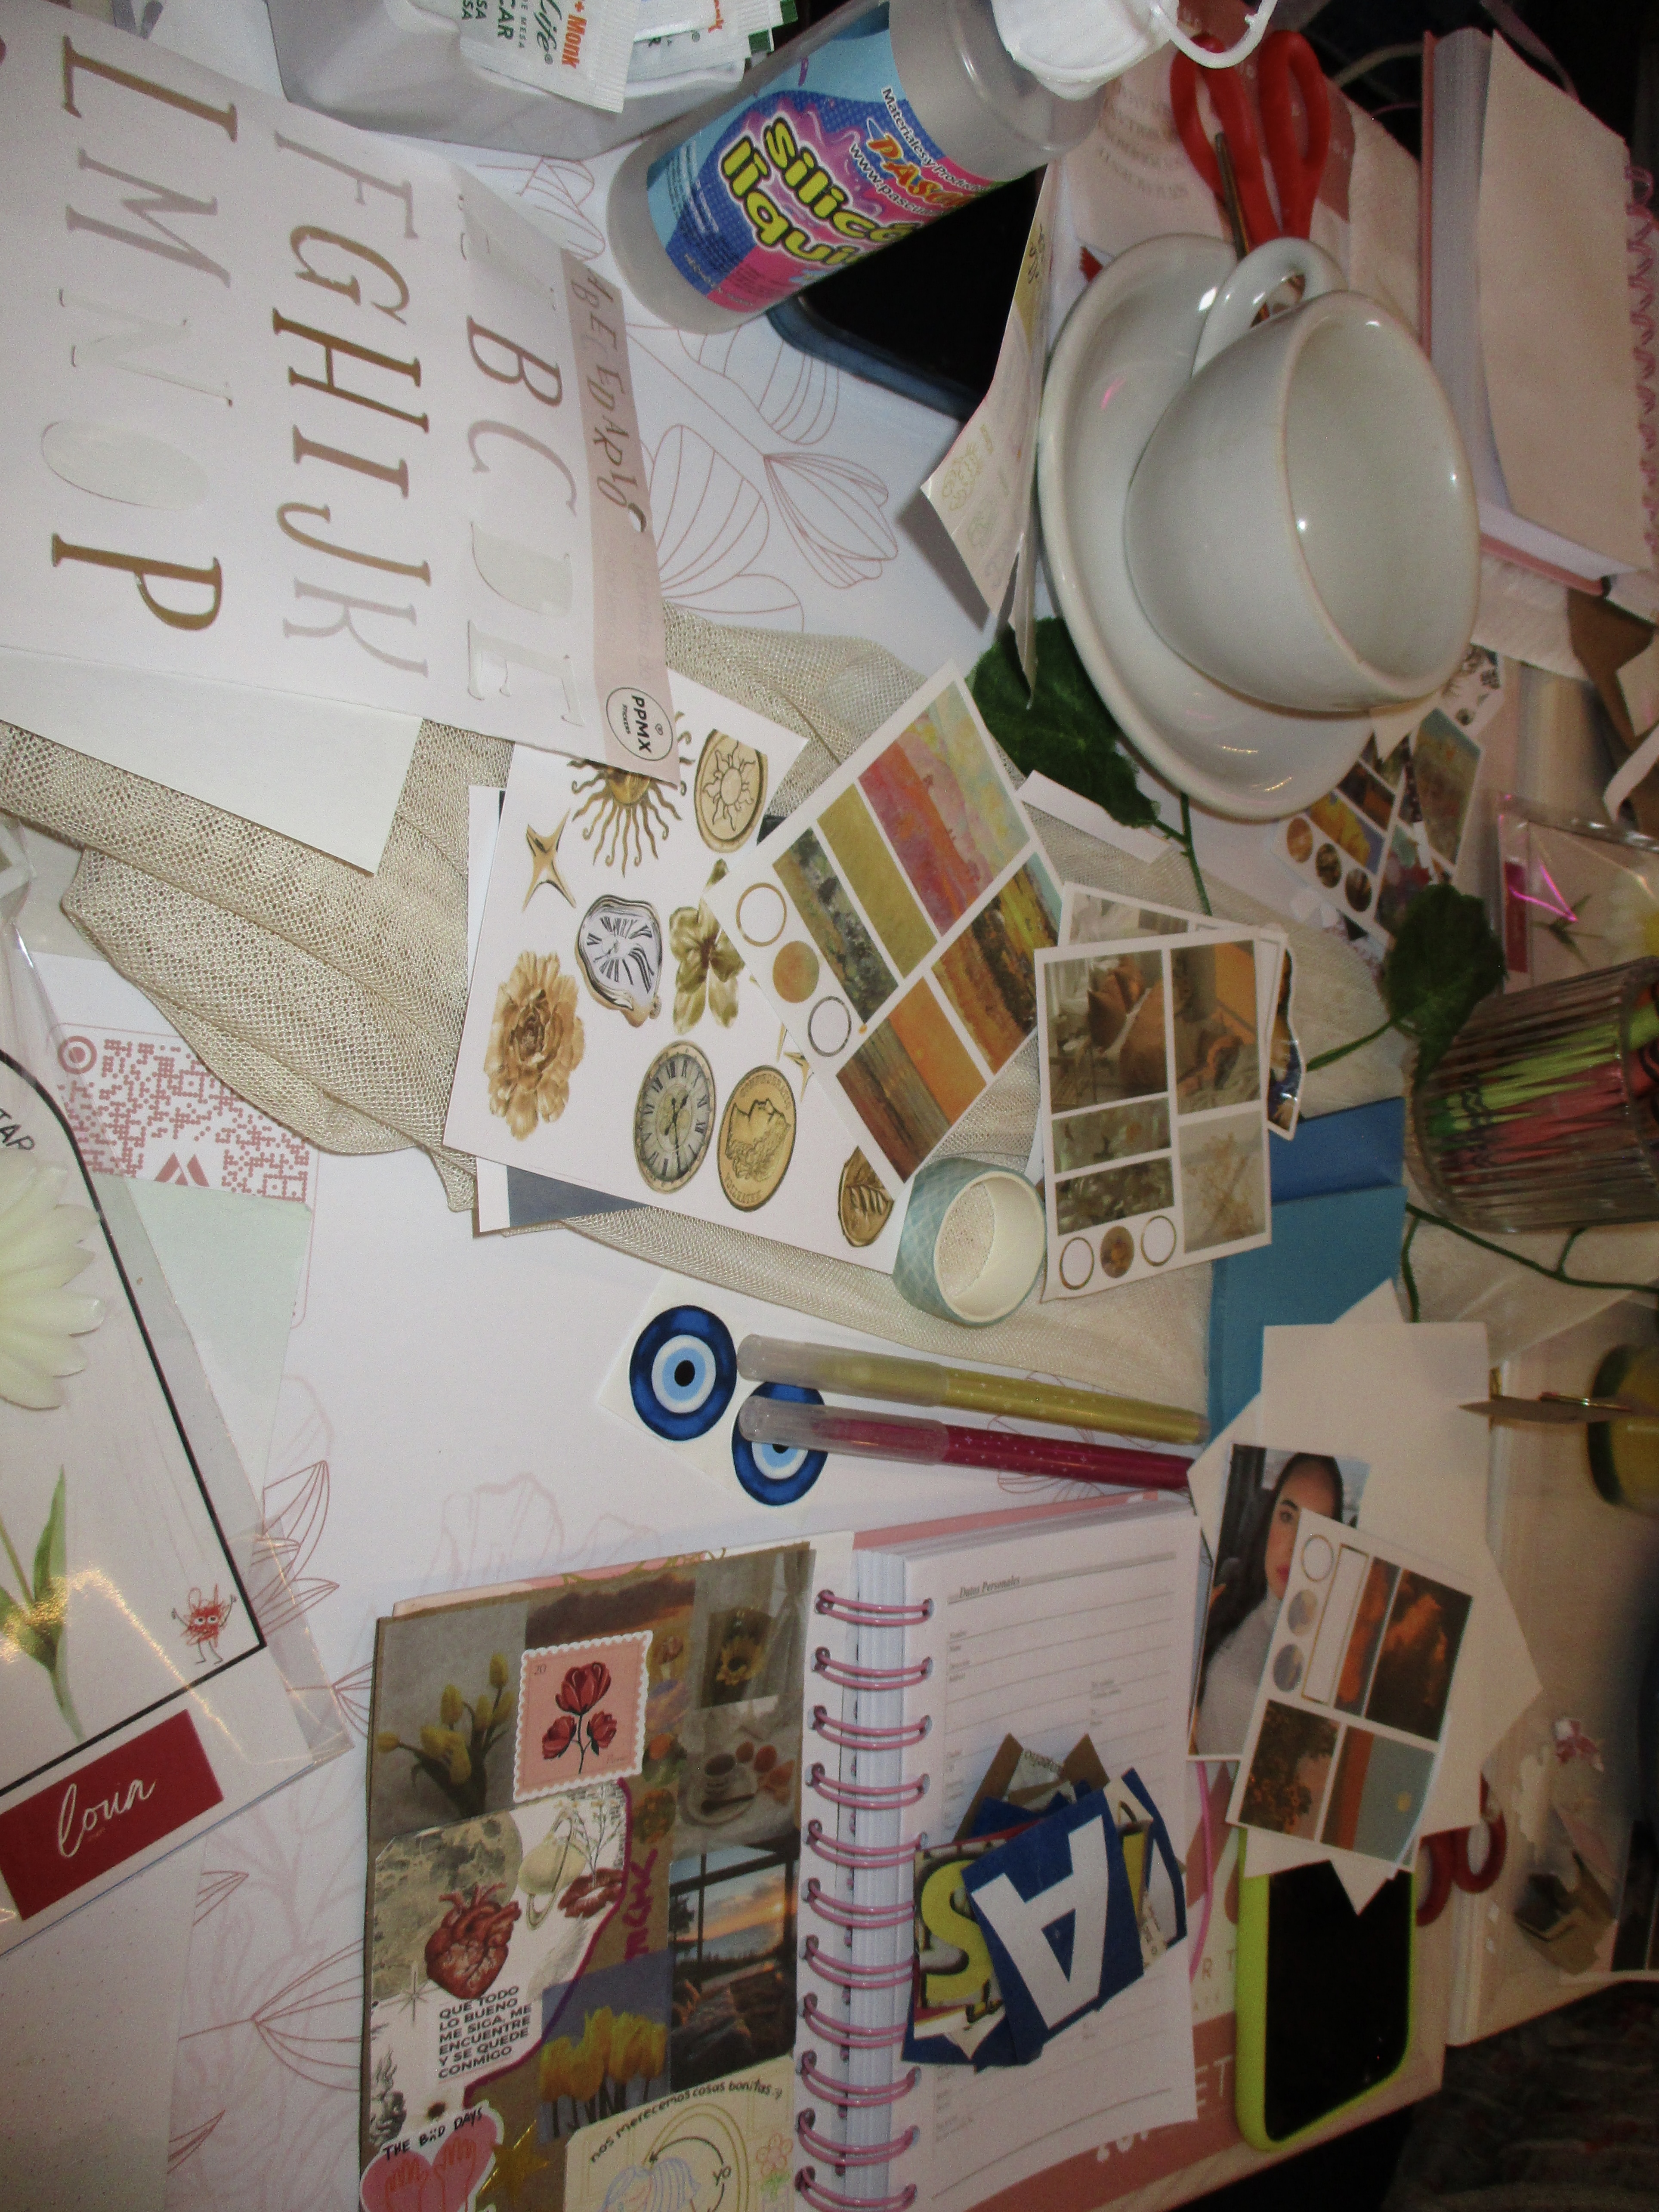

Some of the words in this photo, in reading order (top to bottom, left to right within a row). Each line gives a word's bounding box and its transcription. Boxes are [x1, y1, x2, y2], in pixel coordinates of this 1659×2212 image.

[518, 17, 528, 49] MESA
[562, 14, 587, 69] Monk
[881, 88, 928, 162] Materiales
[631, 695, 652, 754] PPMX
[971, 1814, 1109, 2030] A
[439, 2001, 473, 2020] QUE
[476, 1985, 519, 2007] TODO
[439, 2017, 460, 2032] LO
[463, 1997, 518, 2023] BUENO
[439, 2027, 462, 2043] ME
[510, 2002, 532, 2020] ME
[439, 2014, 531, 2055] ENCUENTRE
[439, 2055, 448, 2066] Y
[453, 2047, 473, 2062] SE
[476, 2027, 528, 2054] QUEDE
[438, 2045, 512, 2079] CONMIGO
[383, 2139, 411, 2161] THE
[454, 2107, 483, 2131] DAYS
